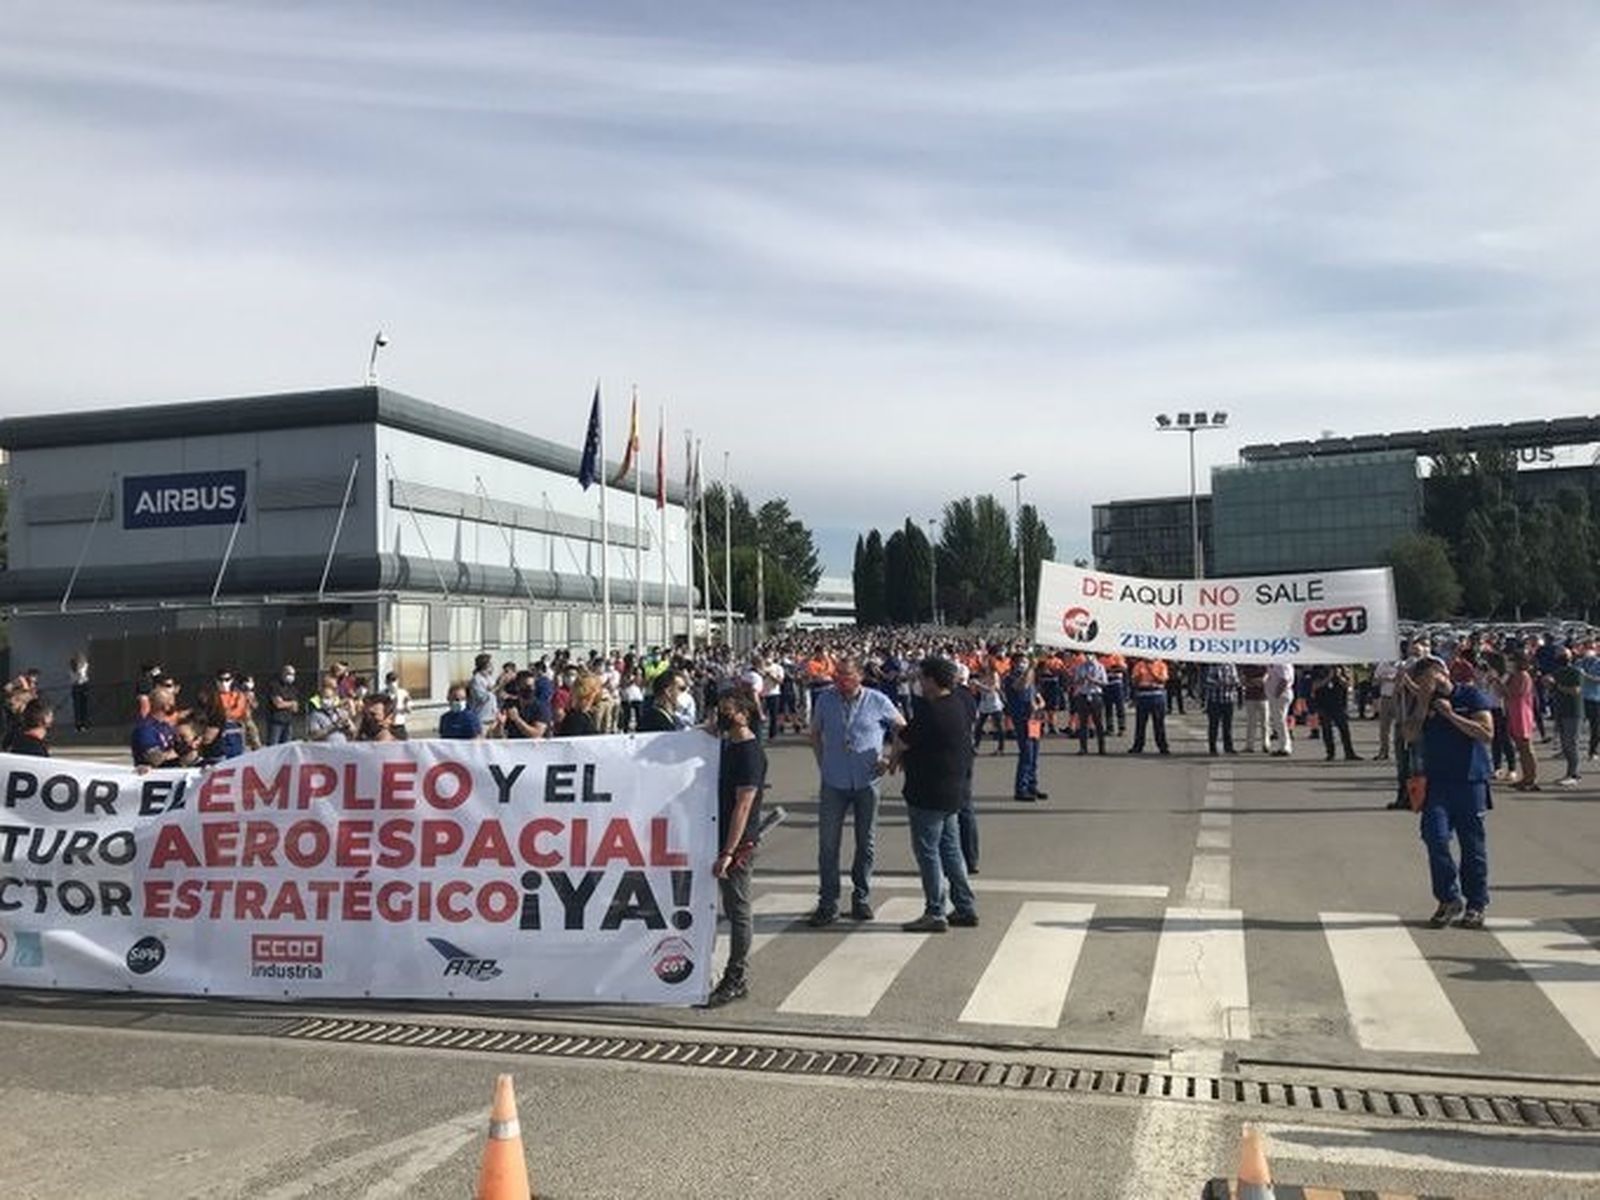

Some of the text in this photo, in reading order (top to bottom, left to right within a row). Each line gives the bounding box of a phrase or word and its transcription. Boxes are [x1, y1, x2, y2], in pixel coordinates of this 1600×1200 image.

[134, 485, 237, 514] AIRBUS
[1082, 578, 1324, 606] DE AQUÍ NO SALE
[1154, 612, 1237, 631] NADIE
[1310, 610, 1363, 633] CGT
[5, 771, 119, 816] POR
[197, 761, 473, 813] EMPLEO
[488, 764, 526, 803] Y
[544, 764, 613, 803] EL
[0, 818, 688, 869] TURO AEROESPACIAL
[143, 870, 519, 922] ESTRATÉGICO
[256, 940, 317, 957] CCOO
[251, 963, 322, 979] industria
